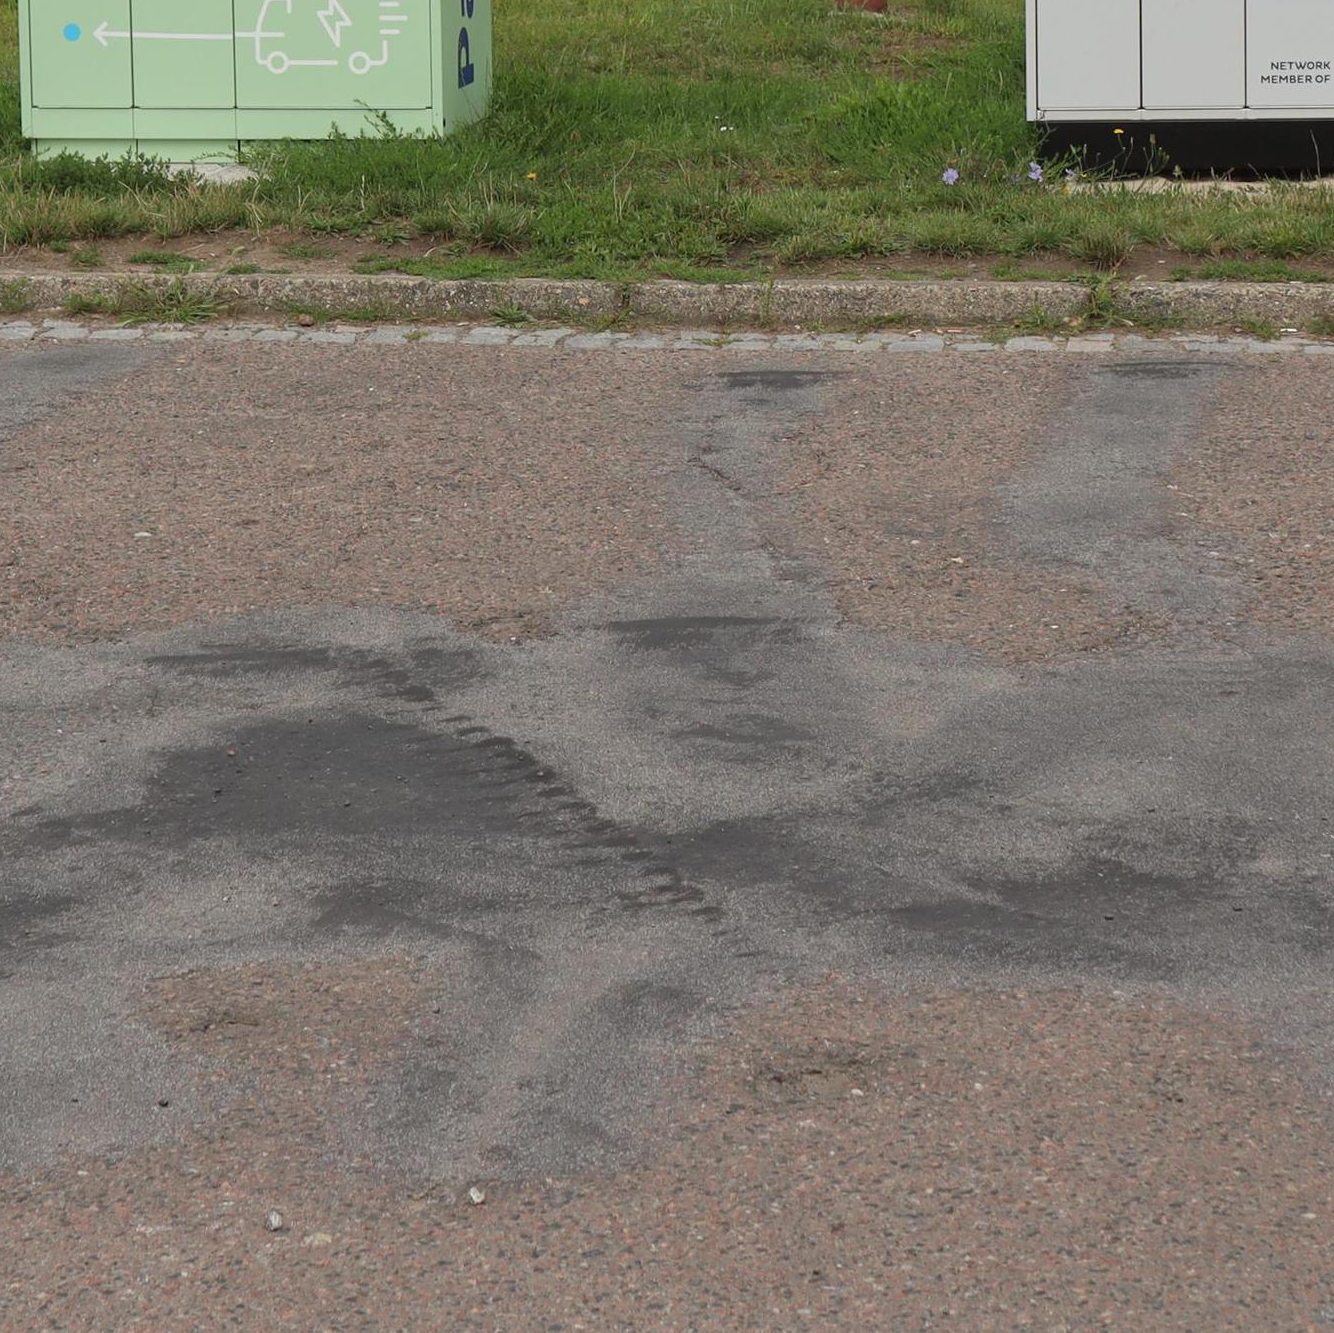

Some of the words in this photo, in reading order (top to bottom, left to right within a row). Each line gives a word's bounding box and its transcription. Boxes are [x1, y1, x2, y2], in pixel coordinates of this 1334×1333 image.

[1270, 61, 1331, 72] NETWORK
[1260, 74, 1313, 84] MEMBER
[1314, 74, 1331, 84] OF
